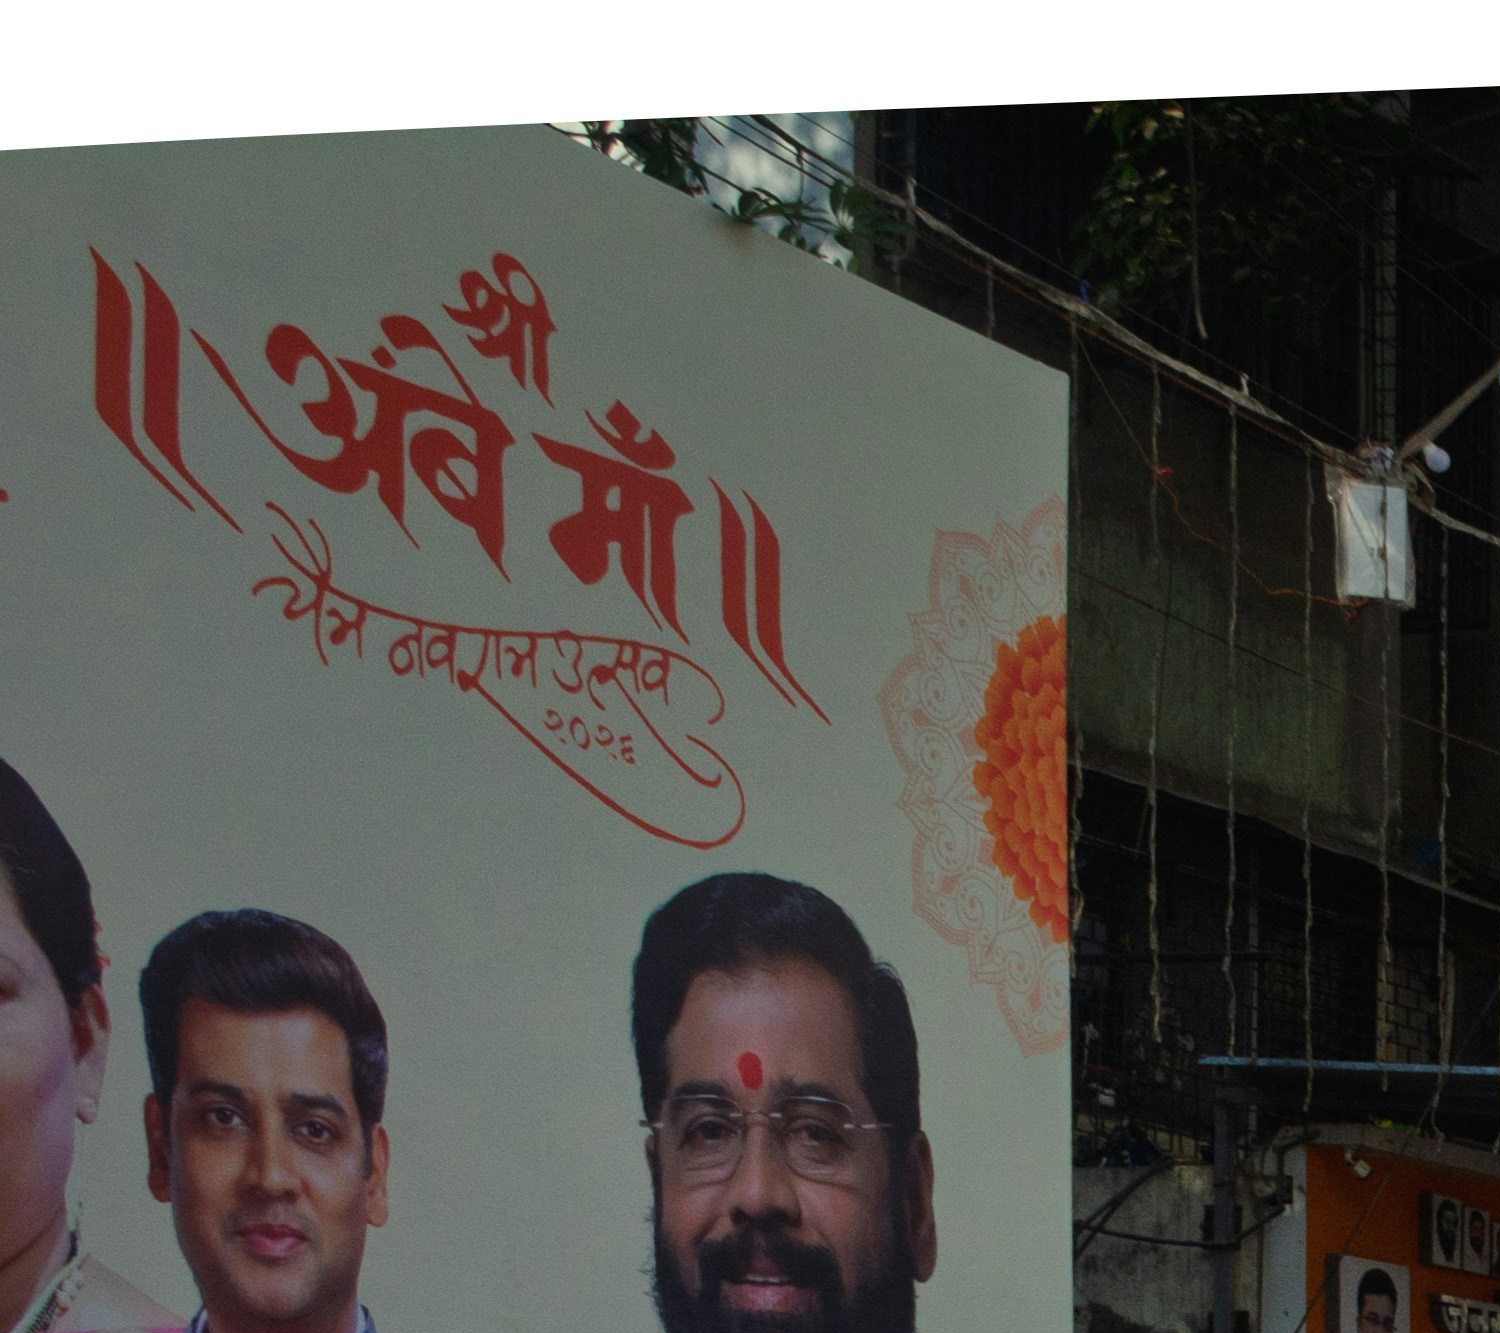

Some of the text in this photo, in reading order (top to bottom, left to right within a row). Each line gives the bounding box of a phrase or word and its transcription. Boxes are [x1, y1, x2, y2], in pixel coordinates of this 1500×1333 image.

[443, 252, 560, 407] श्री
[190, 315, 517, 582] अंबे
[531, 400, 697, 644] माँ
[252, 502, 371, 667] चैत्र
